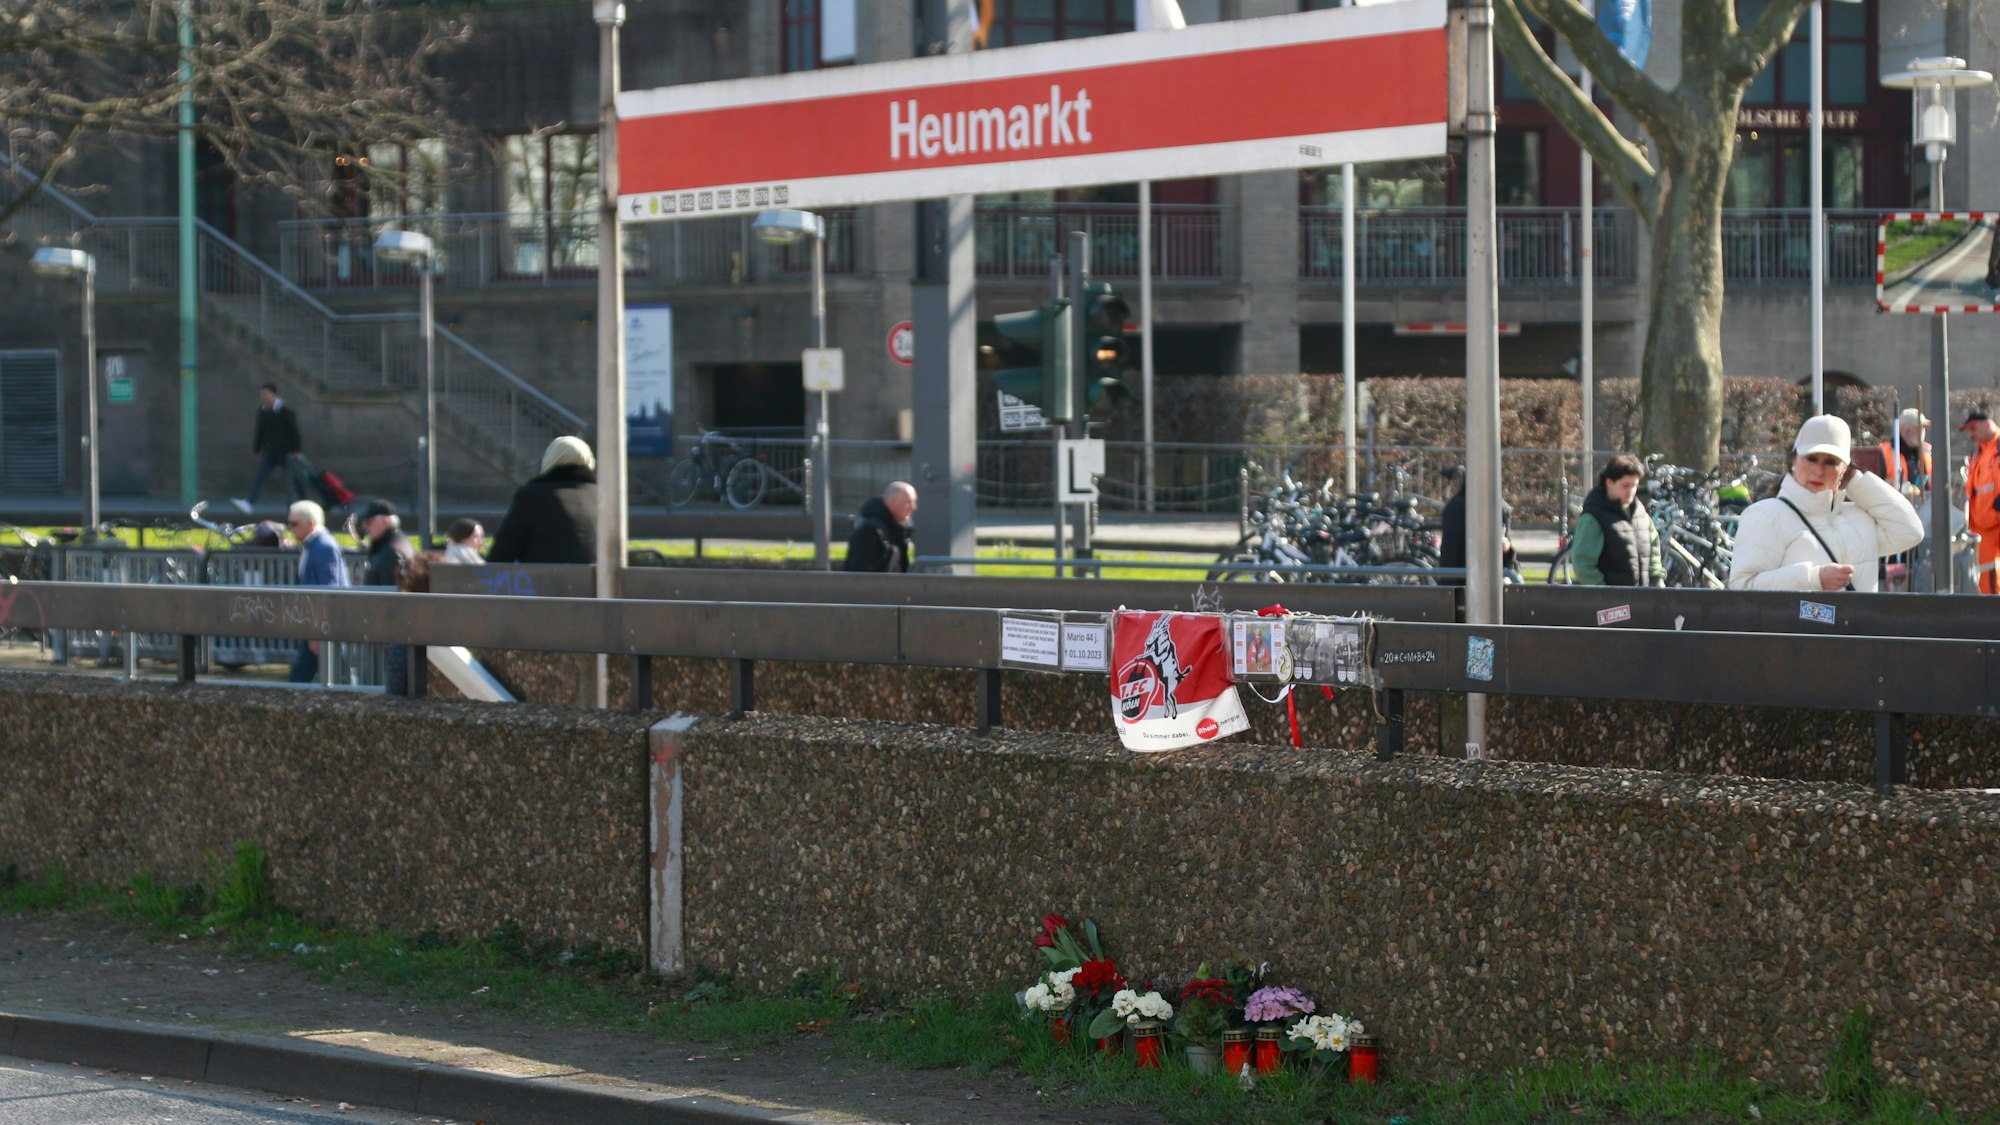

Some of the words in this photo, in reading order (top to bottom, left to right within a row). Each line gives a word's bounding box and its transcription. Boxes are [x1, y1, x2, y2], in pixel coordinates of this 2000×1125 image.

[889, 84, 1093, 161] Heumarkt
[1736, 107, 1800, 128] ÖLSCHE
[1066, 632, 1085, 641] Mario
[1086, 633, 1093, 642] 44
[1069, 649, 1102, 660] 01.10.2023
[1122, 698, 1140, 711] KÖLN
